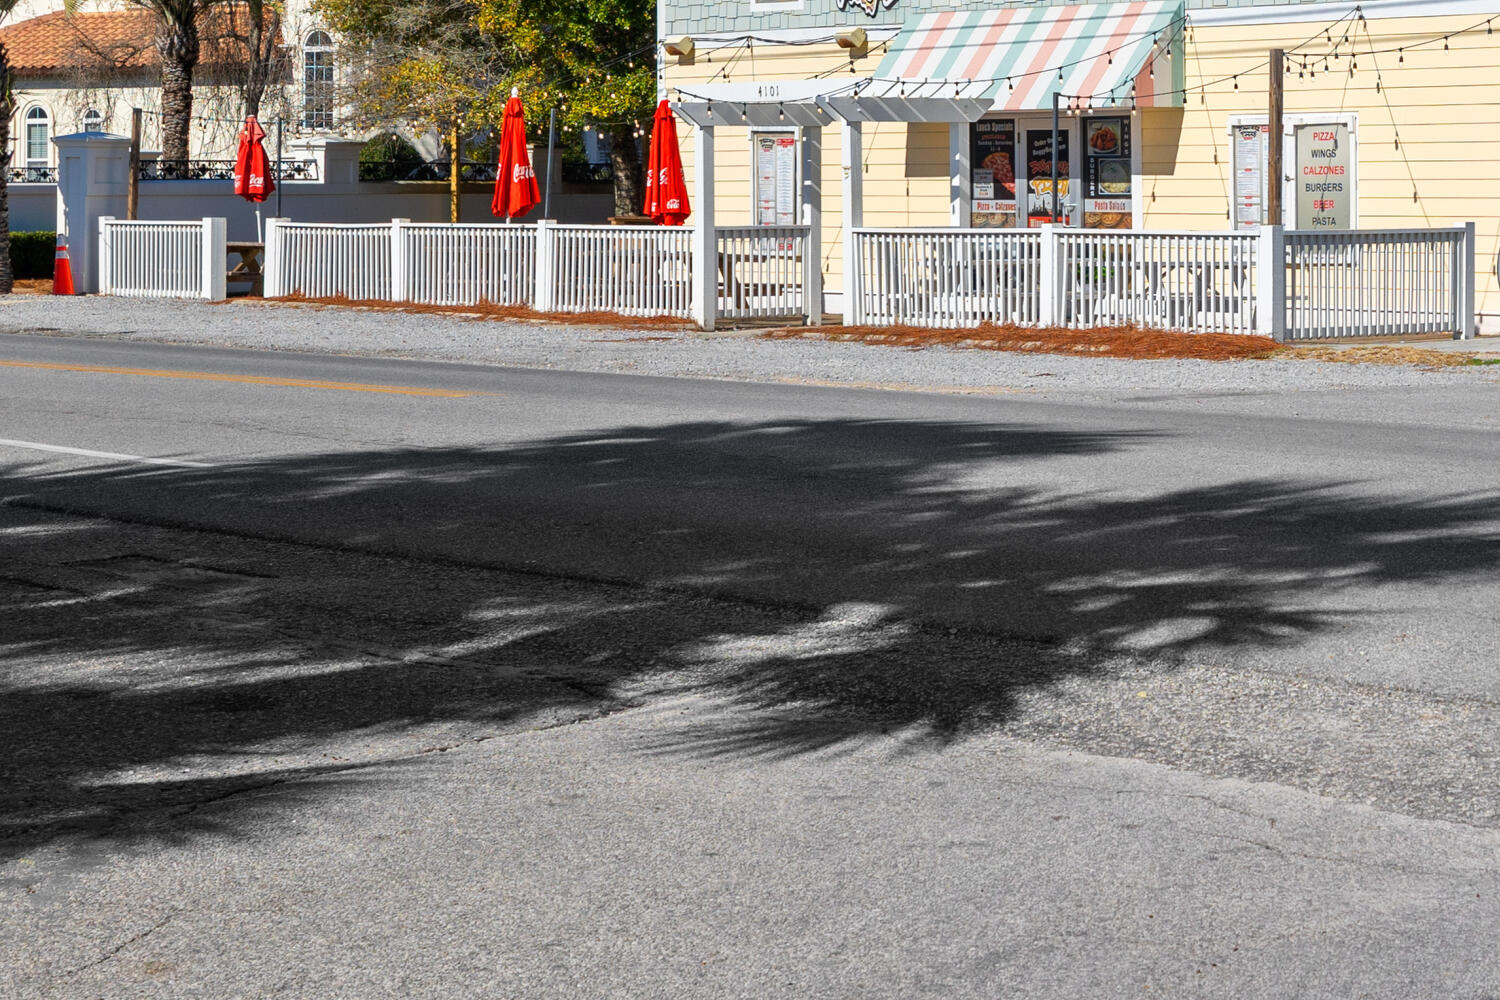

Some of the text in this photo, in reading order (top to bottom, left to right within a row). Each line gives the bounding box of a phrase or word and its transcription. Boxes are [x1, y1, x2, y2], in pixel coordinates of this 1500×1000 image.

[758, 85, 779, 97] 4101
[1312, 132, 1335, 141] PIZZA
[1311, 149, 1336, 158] WINGS
[1303, 165, 1345, 175] CALZONES
[1305, 183, 1343, 192] BURGERS
[1313, 200, 1335, 209] BEER
[1311, 217, 1337, 226] PASTA
